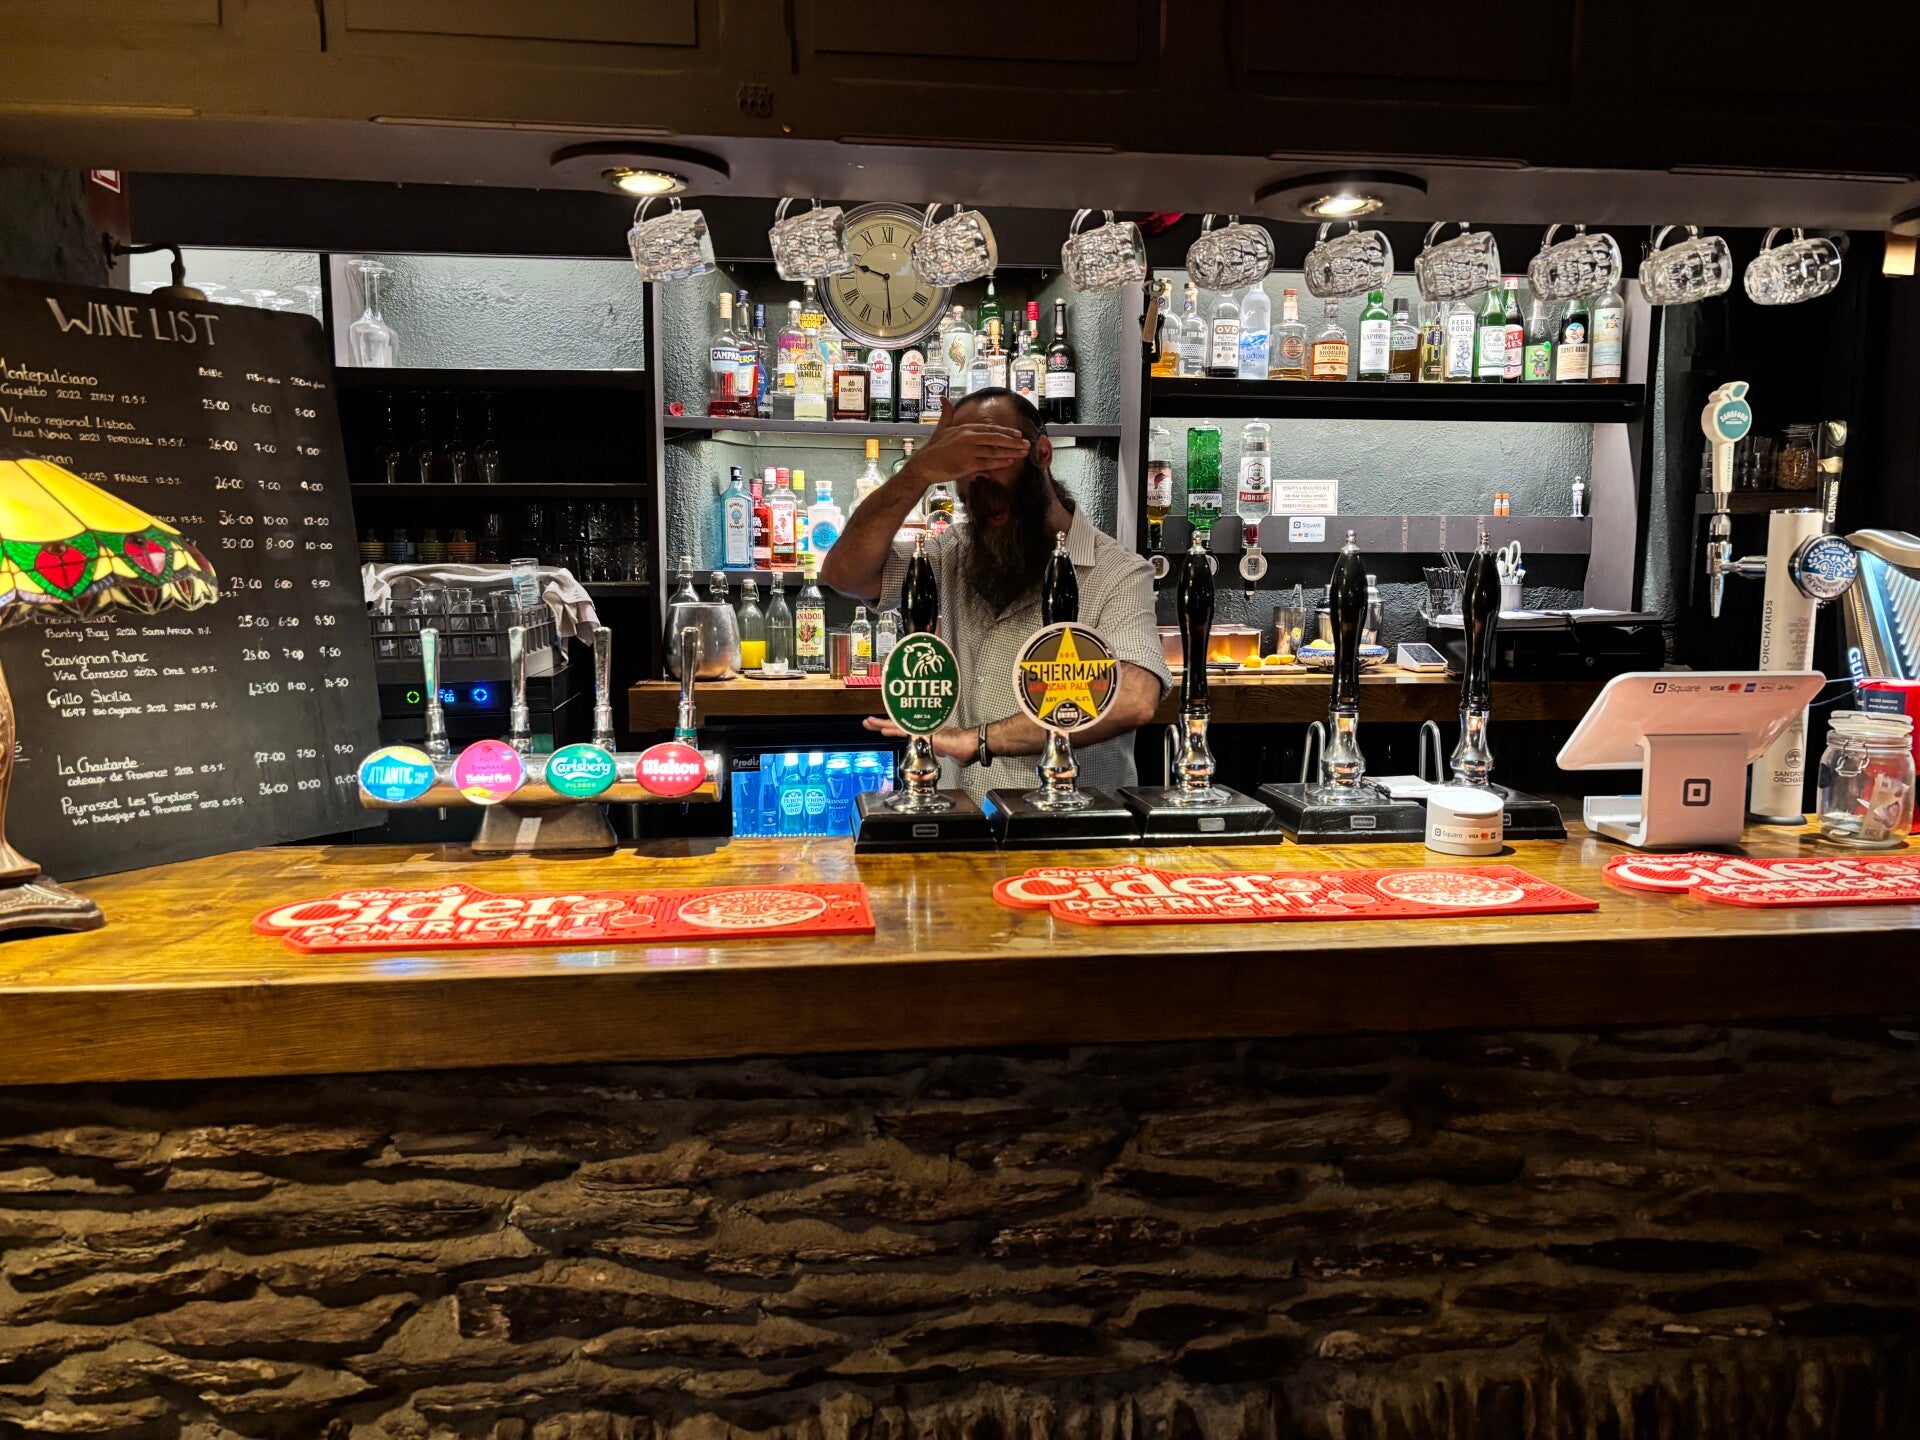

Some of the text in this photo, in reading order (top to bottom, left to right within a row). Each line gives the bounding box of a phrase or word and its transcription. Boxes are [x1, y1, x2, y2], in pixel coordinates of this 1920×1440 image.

[46, 298, 219, 345] WINE LIST
[56, 389, 82, 399] 2022
[0, 407, 135, 431] Vinho regional Lisboa
[12, 427, 35, 438] Lua
[39, 428, 72, 441] Nova
[114, 474, 149, 484] FRANCE
[1825, 481, 1839, 523] GUINNESS
[86, 627, 110, 641] Bay
[1762, 600, 1773, 665] ORCHARDS
[41, 649, 149, 668] Sauvignon Blanc
[80, 667, 128, 681] Carrasco
[1028, 663, 1108, 682] SHERMAN
[889, 680, 954, 697] OTTER
[1668, 683, 1702, 693] Square
[47, 688, 132, 708] Grillo Sicilia
[900, 697, 943, 708] BITTER
[57, 754, 75, 776] La
[551, 757, 611, 778] Carlsberg
[642, 759, 700, 775] Mahou
[109, 773, 124, 782] de
[125, 769, 169, 781] Provence
[367, 766, 414, 785] ATLANTIC
[128, 796, 147, 807] Les
[138, 808, 152, 817] de
[152, 803, 193, 815] Provence
[1442, 831, 1463, 839] Square
[1616, 859, 1873, 887] Cider
[1006, 873, 1273, 901] Cider
[268, 894, 586, 928] Cider
[1066, 897, 1166, 912] DONE
[302, 921, 420, 938] DONE
